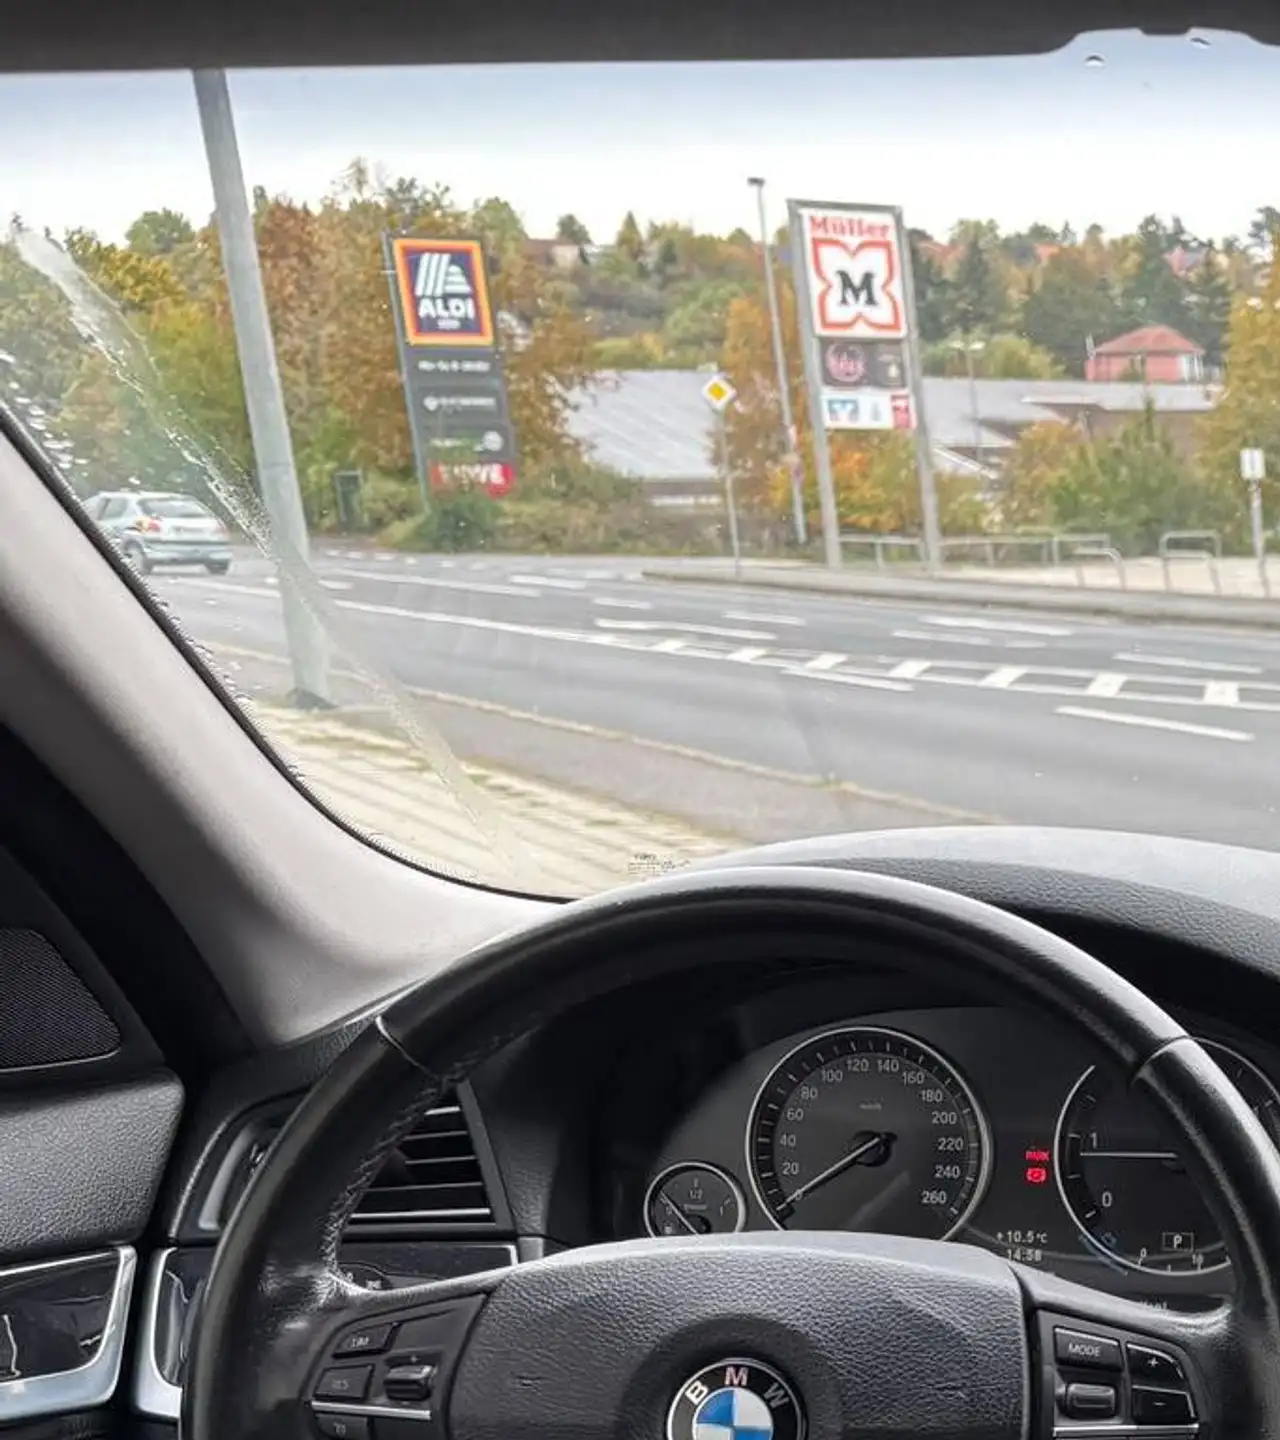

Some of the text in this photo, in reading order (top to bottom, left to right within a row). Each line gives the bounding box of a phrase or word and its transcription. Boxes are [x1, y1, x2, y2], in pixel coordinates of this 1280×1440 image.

[836, 270, 877, 306] M
[419, 298, 475, 319] ALDI
[847, 1057, 869, 1072] 120
[877, 1058, 899, 1073] 140
[821, 1068, 844, 1083] 100
[902, 1070, 925, 1085] 160
[801, 1086, 818, 1100] 80
[921, 1088, 943, 1103] 180
[787, 1108, 803, 1121] 60
[931, 1110, 957, 1125] 200
[780, 1134, 796, 1148] 40
[938, 1137, 963, 1152] 220
[1090, 1132, 1098, 1149] 1
[782, 1161, 799, 1175] 20
[934, 1164, 960, 1179] 240
[921, 1190, 947, 1204] 260
[1102, 1191, 1113, 1207] 0
[1173, 1233, 1183, 1249] P
[1067, 1342, 1101, 1357] MODE
[685, 1366, 790, 1409] BMW
